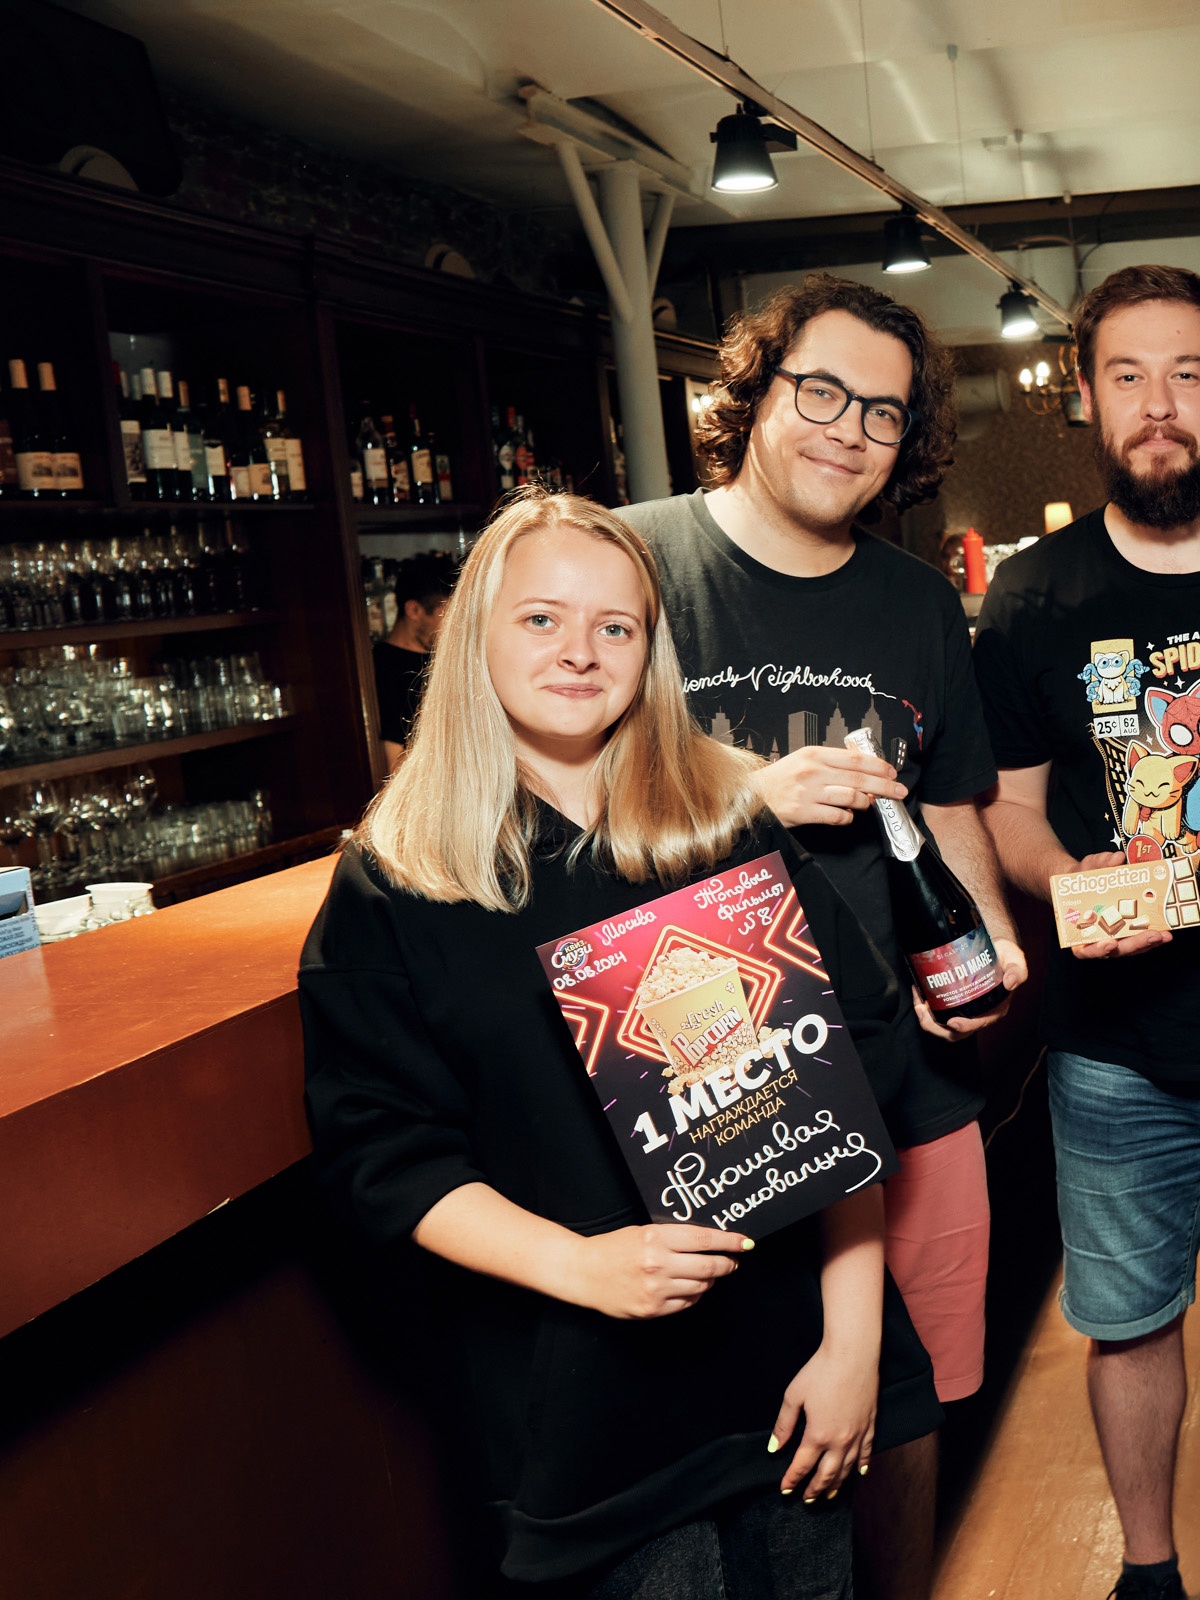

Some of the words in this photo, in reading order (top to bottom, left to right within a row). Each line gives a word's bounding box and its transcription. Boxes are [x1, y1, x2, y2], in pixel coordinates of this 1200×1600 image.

[1167, 633, 1190, 646] THE
[1123, 717, 1136, 729] 62
[1123, 727, 1138, 735] AUG
[892, 821, 901, 832] DI
[1135, 840, 1152, 859] 1ST
[1058, 868, 1150, 896] Schogetten
[601, 909, 657, 946] Москва
[551, 943, 594, 969] Смузи
[565, 940, 586, 953] КВИЗ
[553, 951, 628, 991] 08.08.2024
[926, 970, 955, 989] FIORI
[954, 964, 968, 980] DI
[966, 949, 993, 974] MARE
[633, 1111, 669, 1154] 1
[668, 1013, 829, 1136] МЕСТО
[689, 1069, 798, 1144] НАГРАЖДАЕТСЯ
[714, 1096, 786, 1147] КОМАНДА
